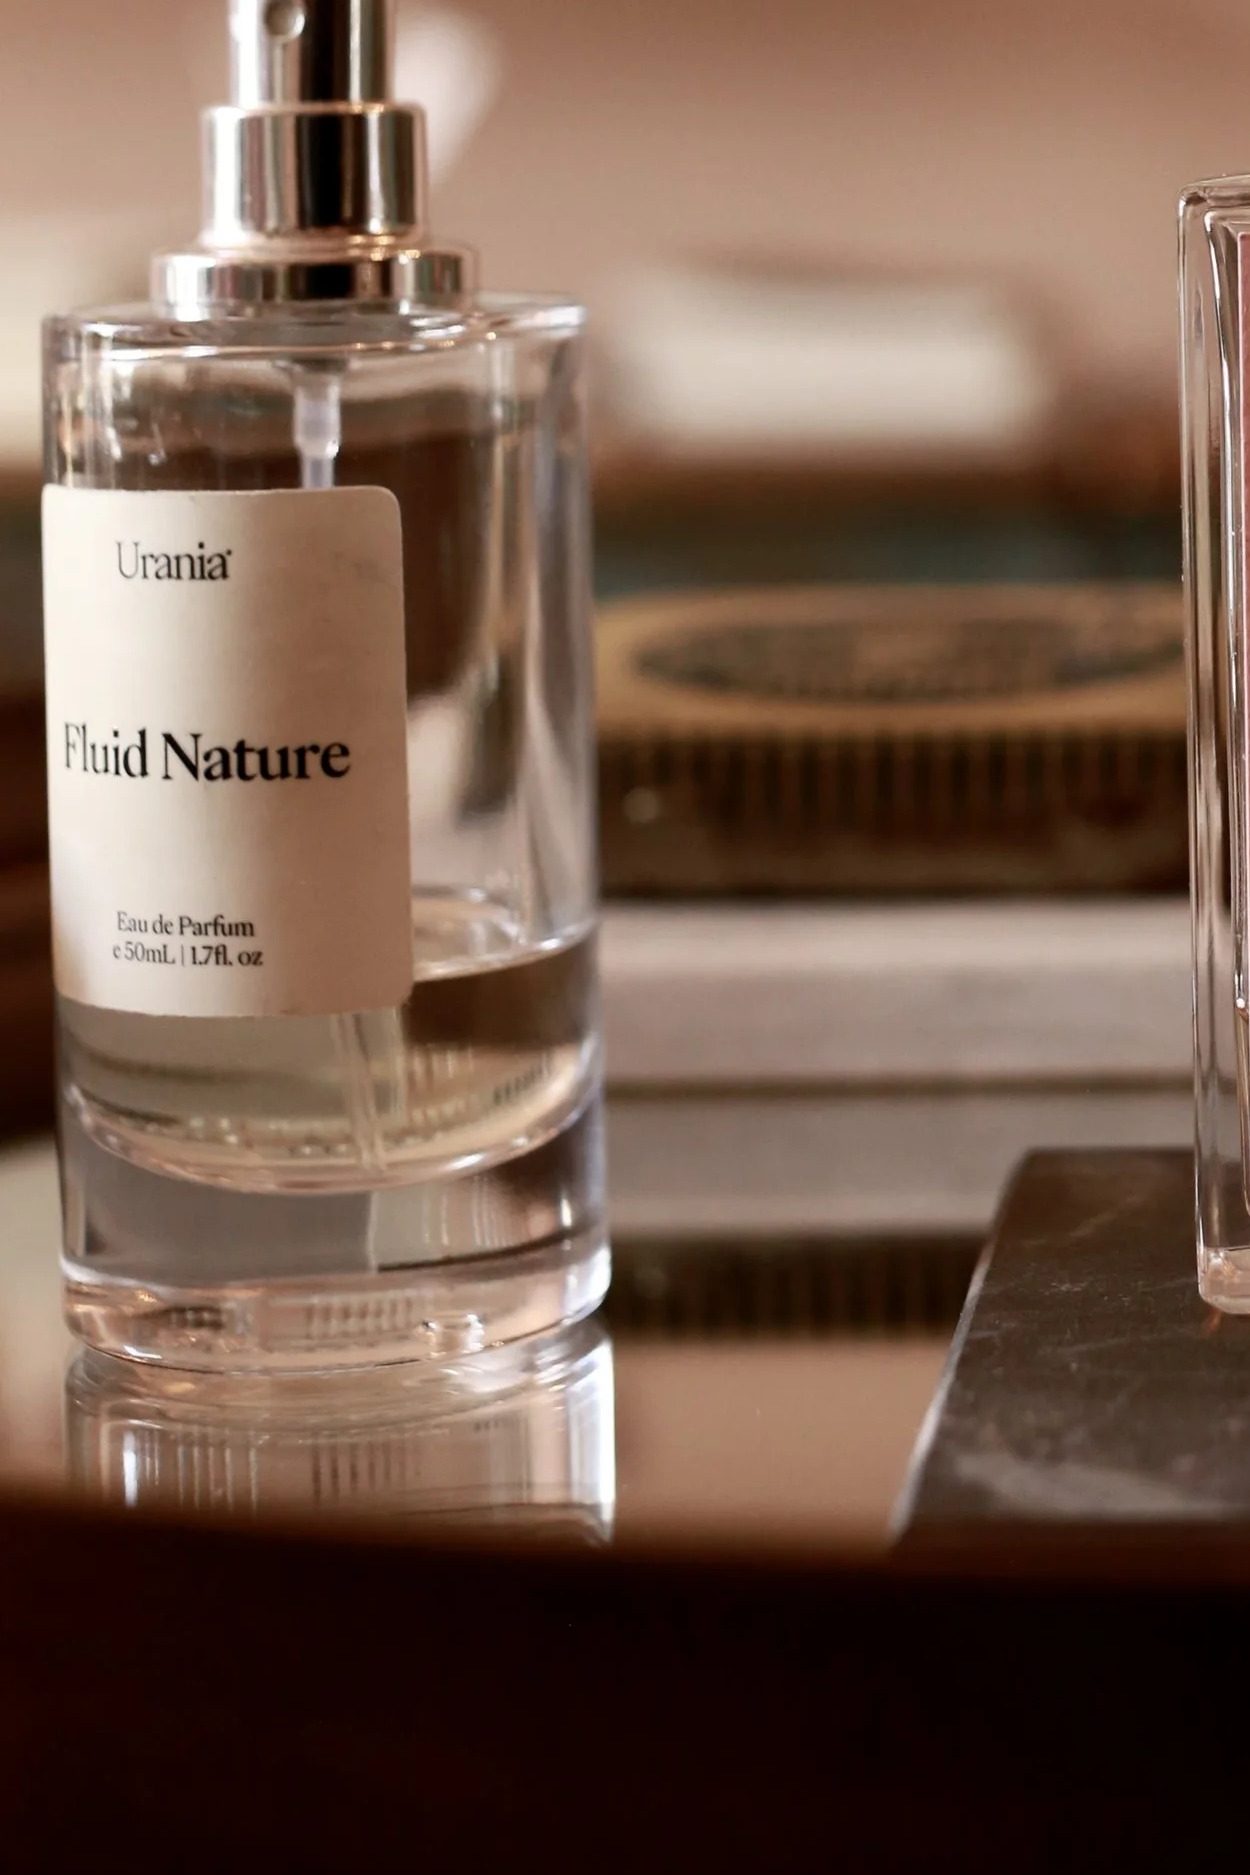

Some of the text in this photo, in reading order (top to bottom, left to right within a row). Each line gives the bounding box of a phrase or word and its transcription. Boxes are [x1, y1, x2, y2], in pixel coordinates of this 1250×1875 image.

[64, 722, 351, 781] Fluid Nature
[116, 911, 255, 937] Eau de Parfum
[124, 941, 176, 964] 50mL
[237, 951, 264, 966] oz
